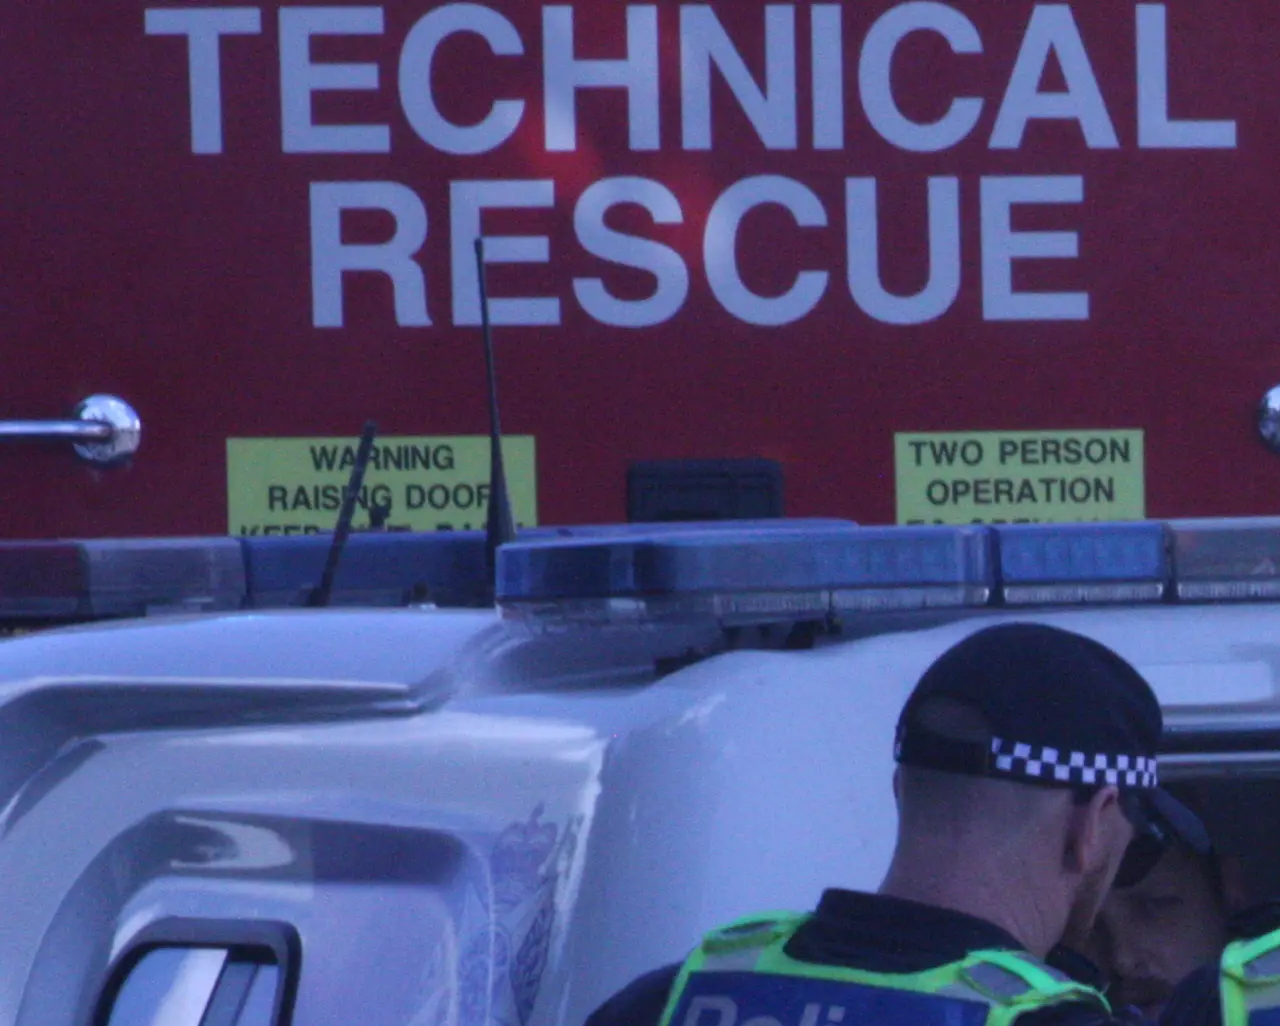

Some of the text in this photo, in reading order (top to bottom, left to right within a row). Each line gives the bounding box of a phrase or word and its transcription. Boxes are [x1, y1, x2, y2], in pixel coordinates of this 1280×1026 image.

[145, 1, 1238, 155] TECHNICAL
[309, 174, 1090, 328] RESCUE
[309, 444, 455, 471] WARNING
[907, 438, 1131, 467] TWO PERSON
[268, 484, 393, 511] RAISING
[926, 476, 1115, 505] OPERATION
